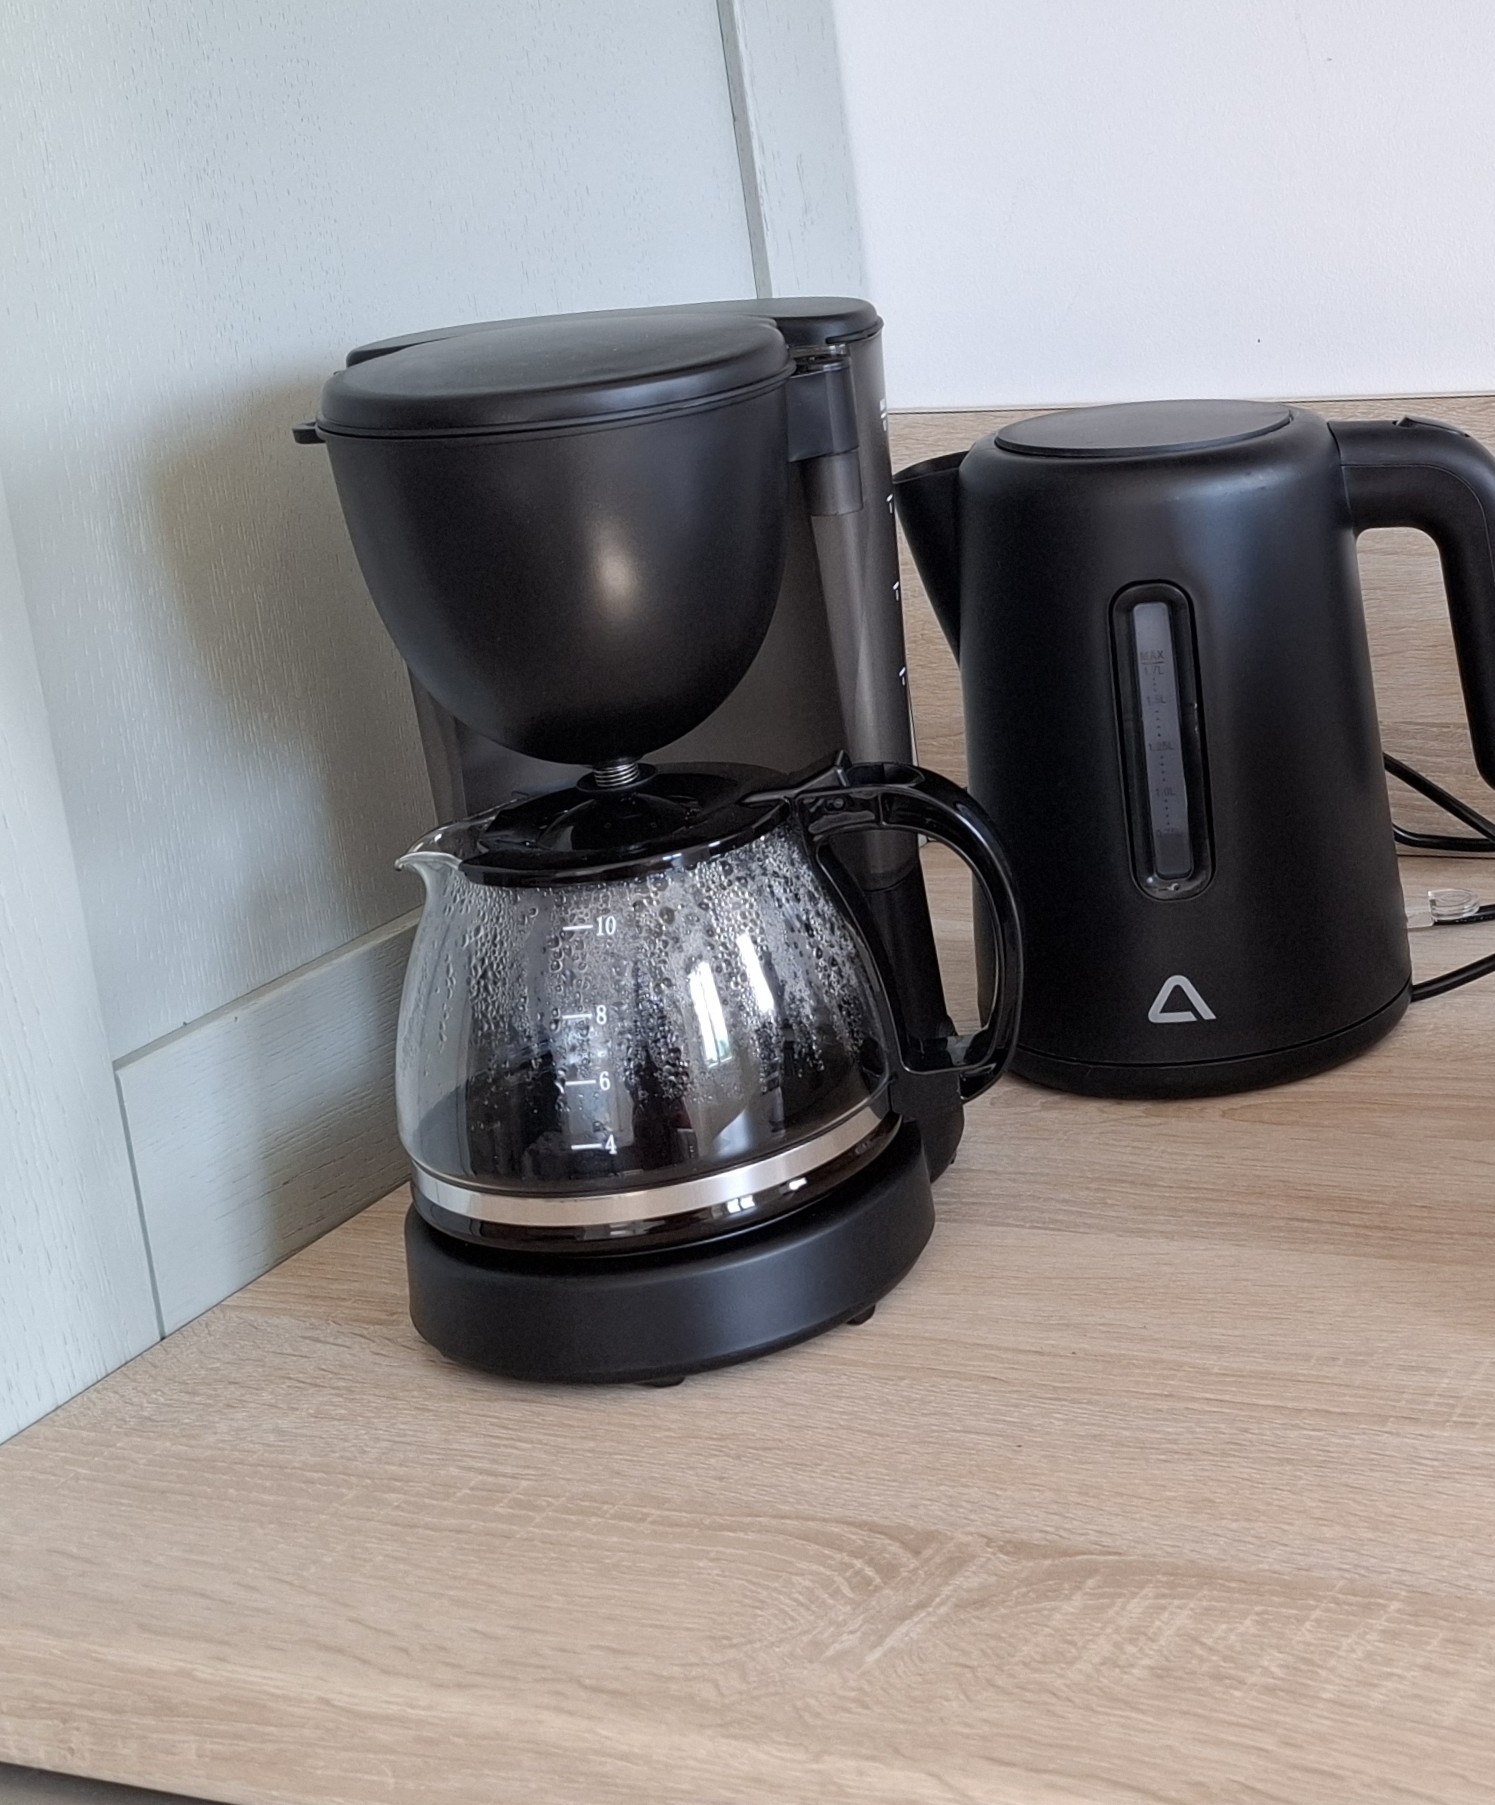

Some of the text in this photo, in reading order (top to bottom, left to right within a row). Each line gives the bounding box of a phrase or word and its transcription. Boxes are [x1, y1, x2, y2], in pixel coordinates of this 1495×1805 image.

[596, 916, 617, 936] 10
[596, 1005, 607, 1025] 8
[599, 1071, 611, 1091] 6
[605, 1134, 617, 1155] 4
